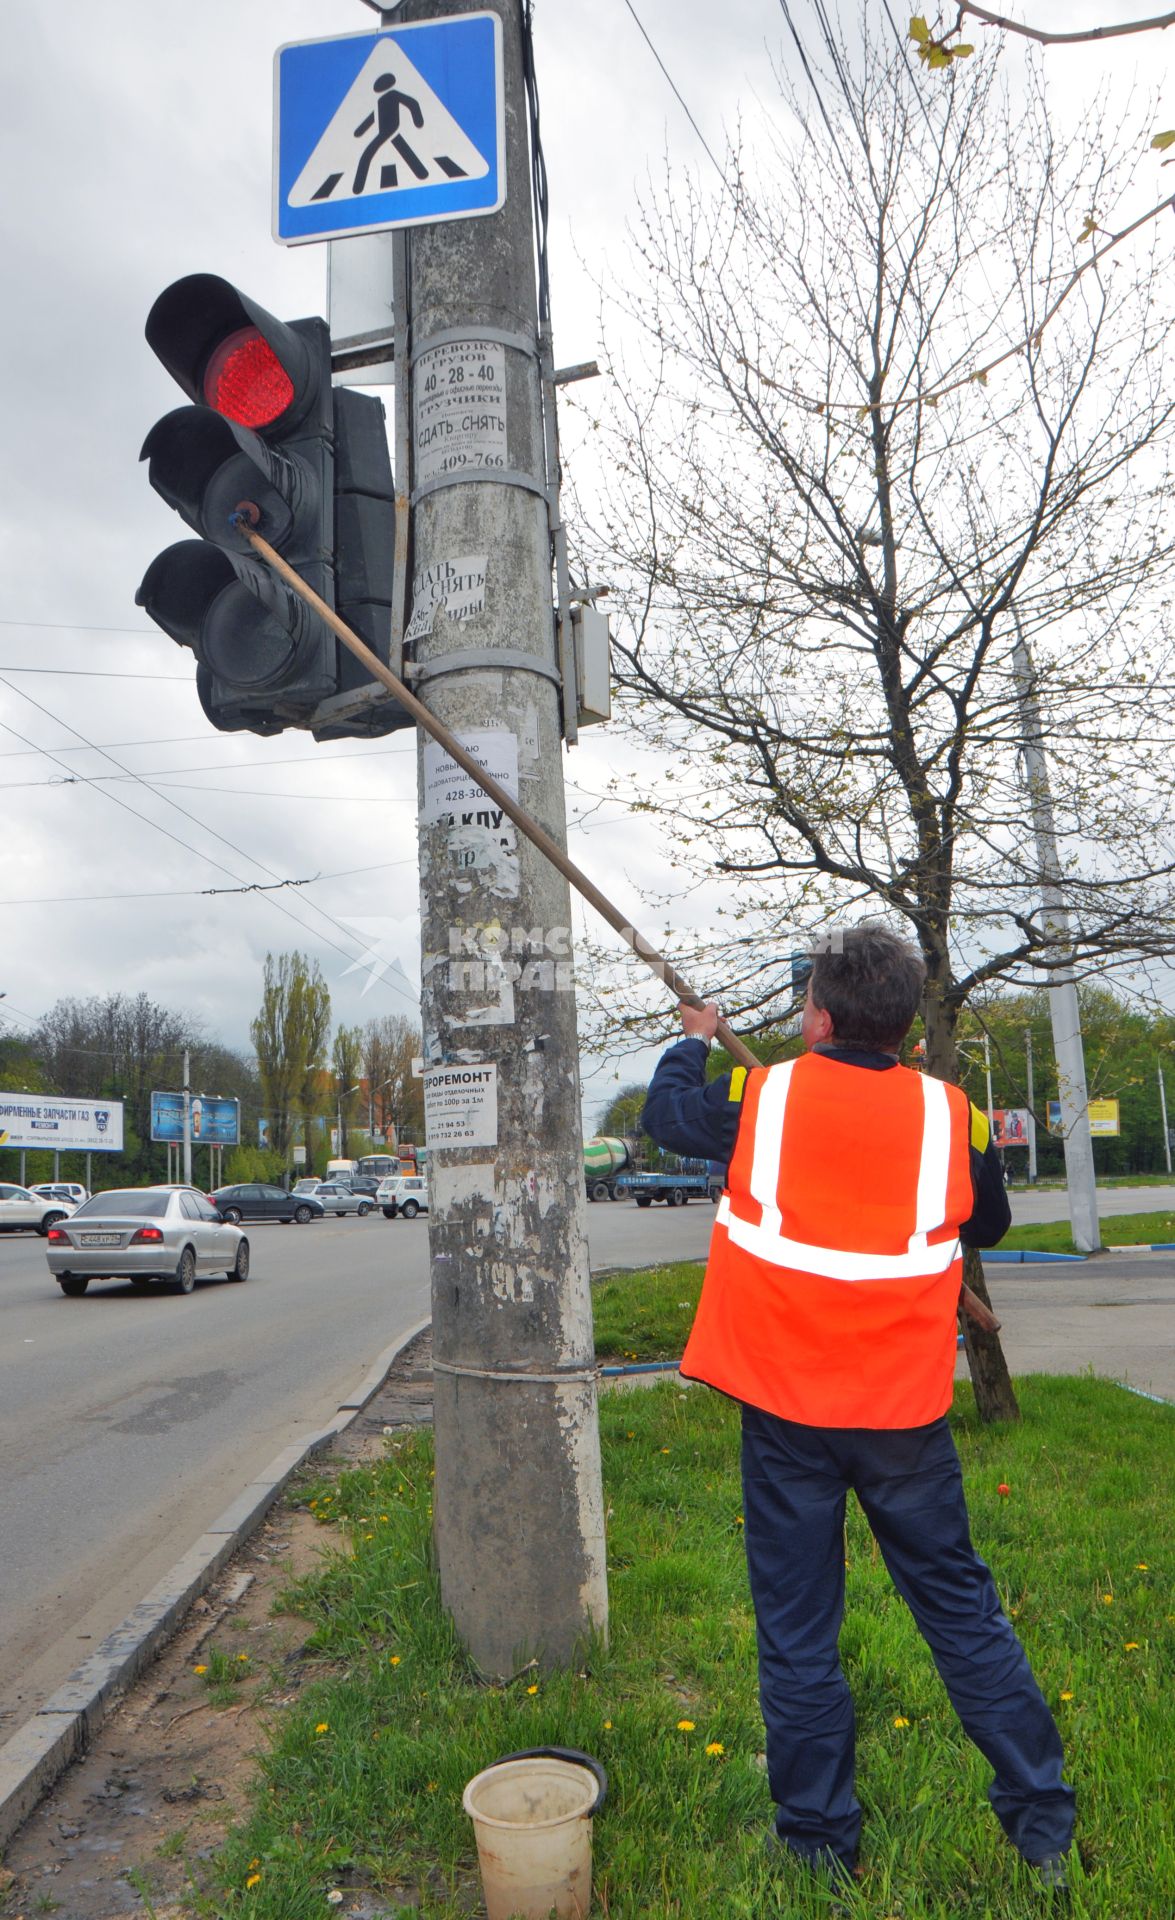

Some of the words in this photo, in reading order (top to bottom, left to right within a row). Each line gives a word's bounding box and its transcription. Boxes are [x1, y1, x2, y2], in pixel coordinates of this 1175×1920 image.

[419, 343, 500, 368] ПЕРЕВОЗКА
[432, 354, 486, 370] ГРУЗОВ
[420, 395, 500, 418] ГРУЗЧИКИ
[418, 419, 453, 448] СДАТЬ
[462, 415, 505, 432] СНЯТЬ
[440, 453, 504, 471] 409-766
[431, 574, 484, 599] СНЯТЬ
[443, 745, 479, 757] ПАЮ
[43, 1108, 77, 1121] ЗАПЧАСТИ
[78, 1110, 89, 1121] ГАЗ
